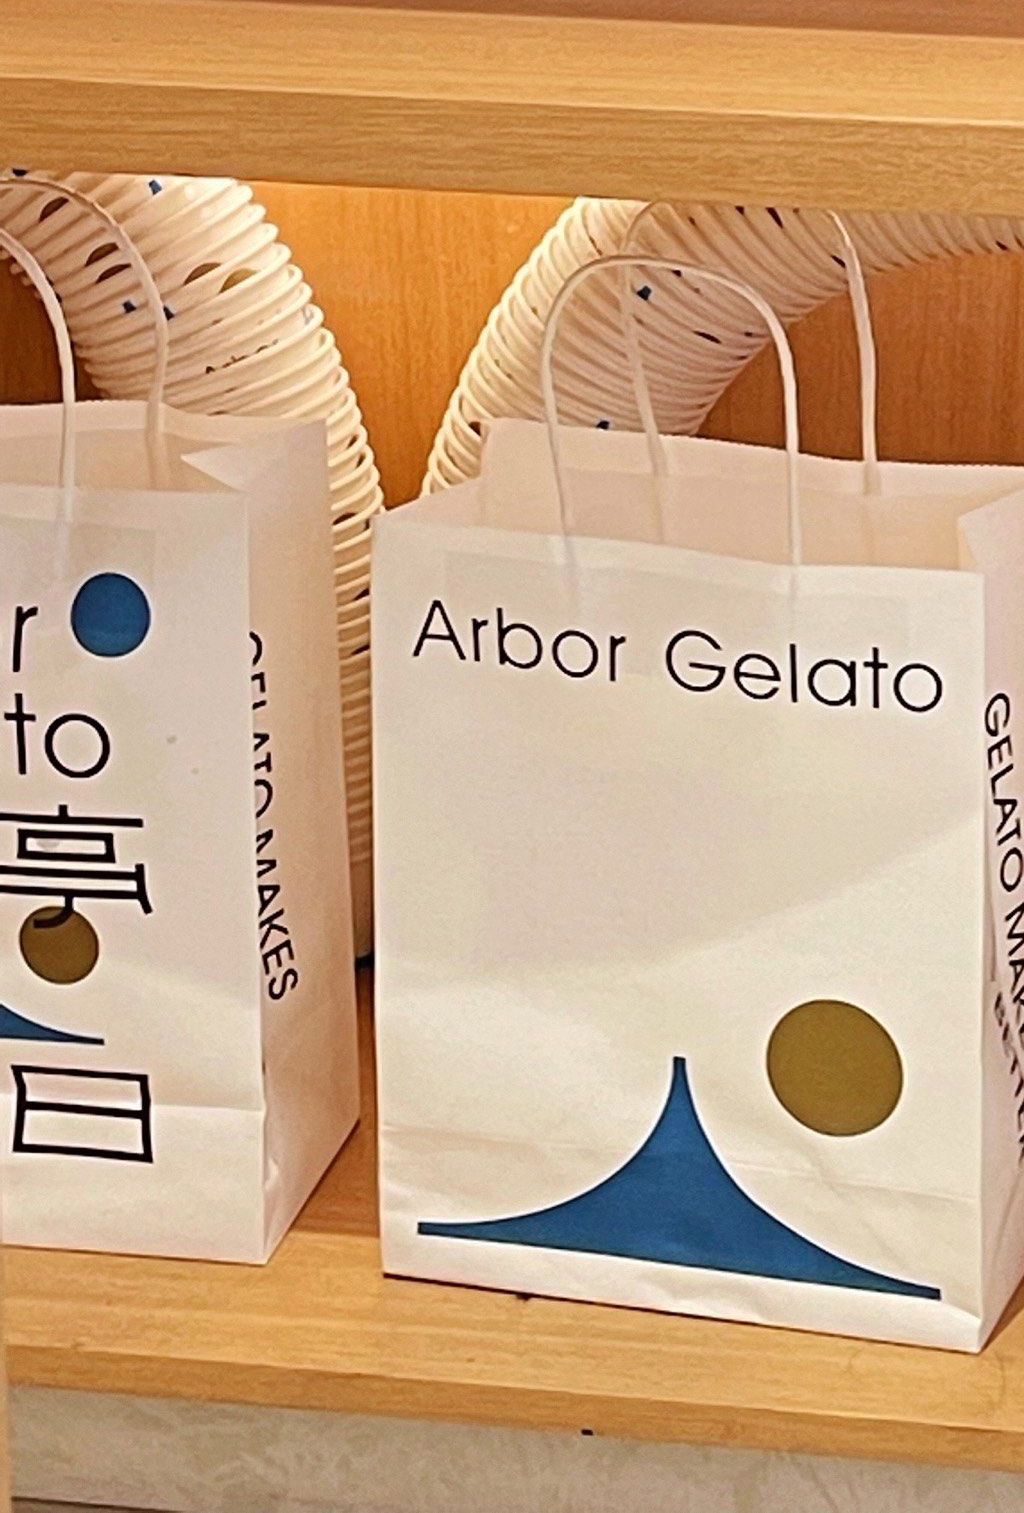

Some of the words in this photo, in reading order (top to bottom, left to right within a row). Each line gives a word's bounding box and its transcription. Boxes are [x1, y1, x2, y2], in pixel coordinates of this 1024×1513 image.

[414, 600, 626, 682] Arbor
[666, 629, 943, 712] Gelato
[984, 692, 1024, 892] GELATO
[0, 804, 153, 929] 亭
[11, 1063, 154, 1164] 日
